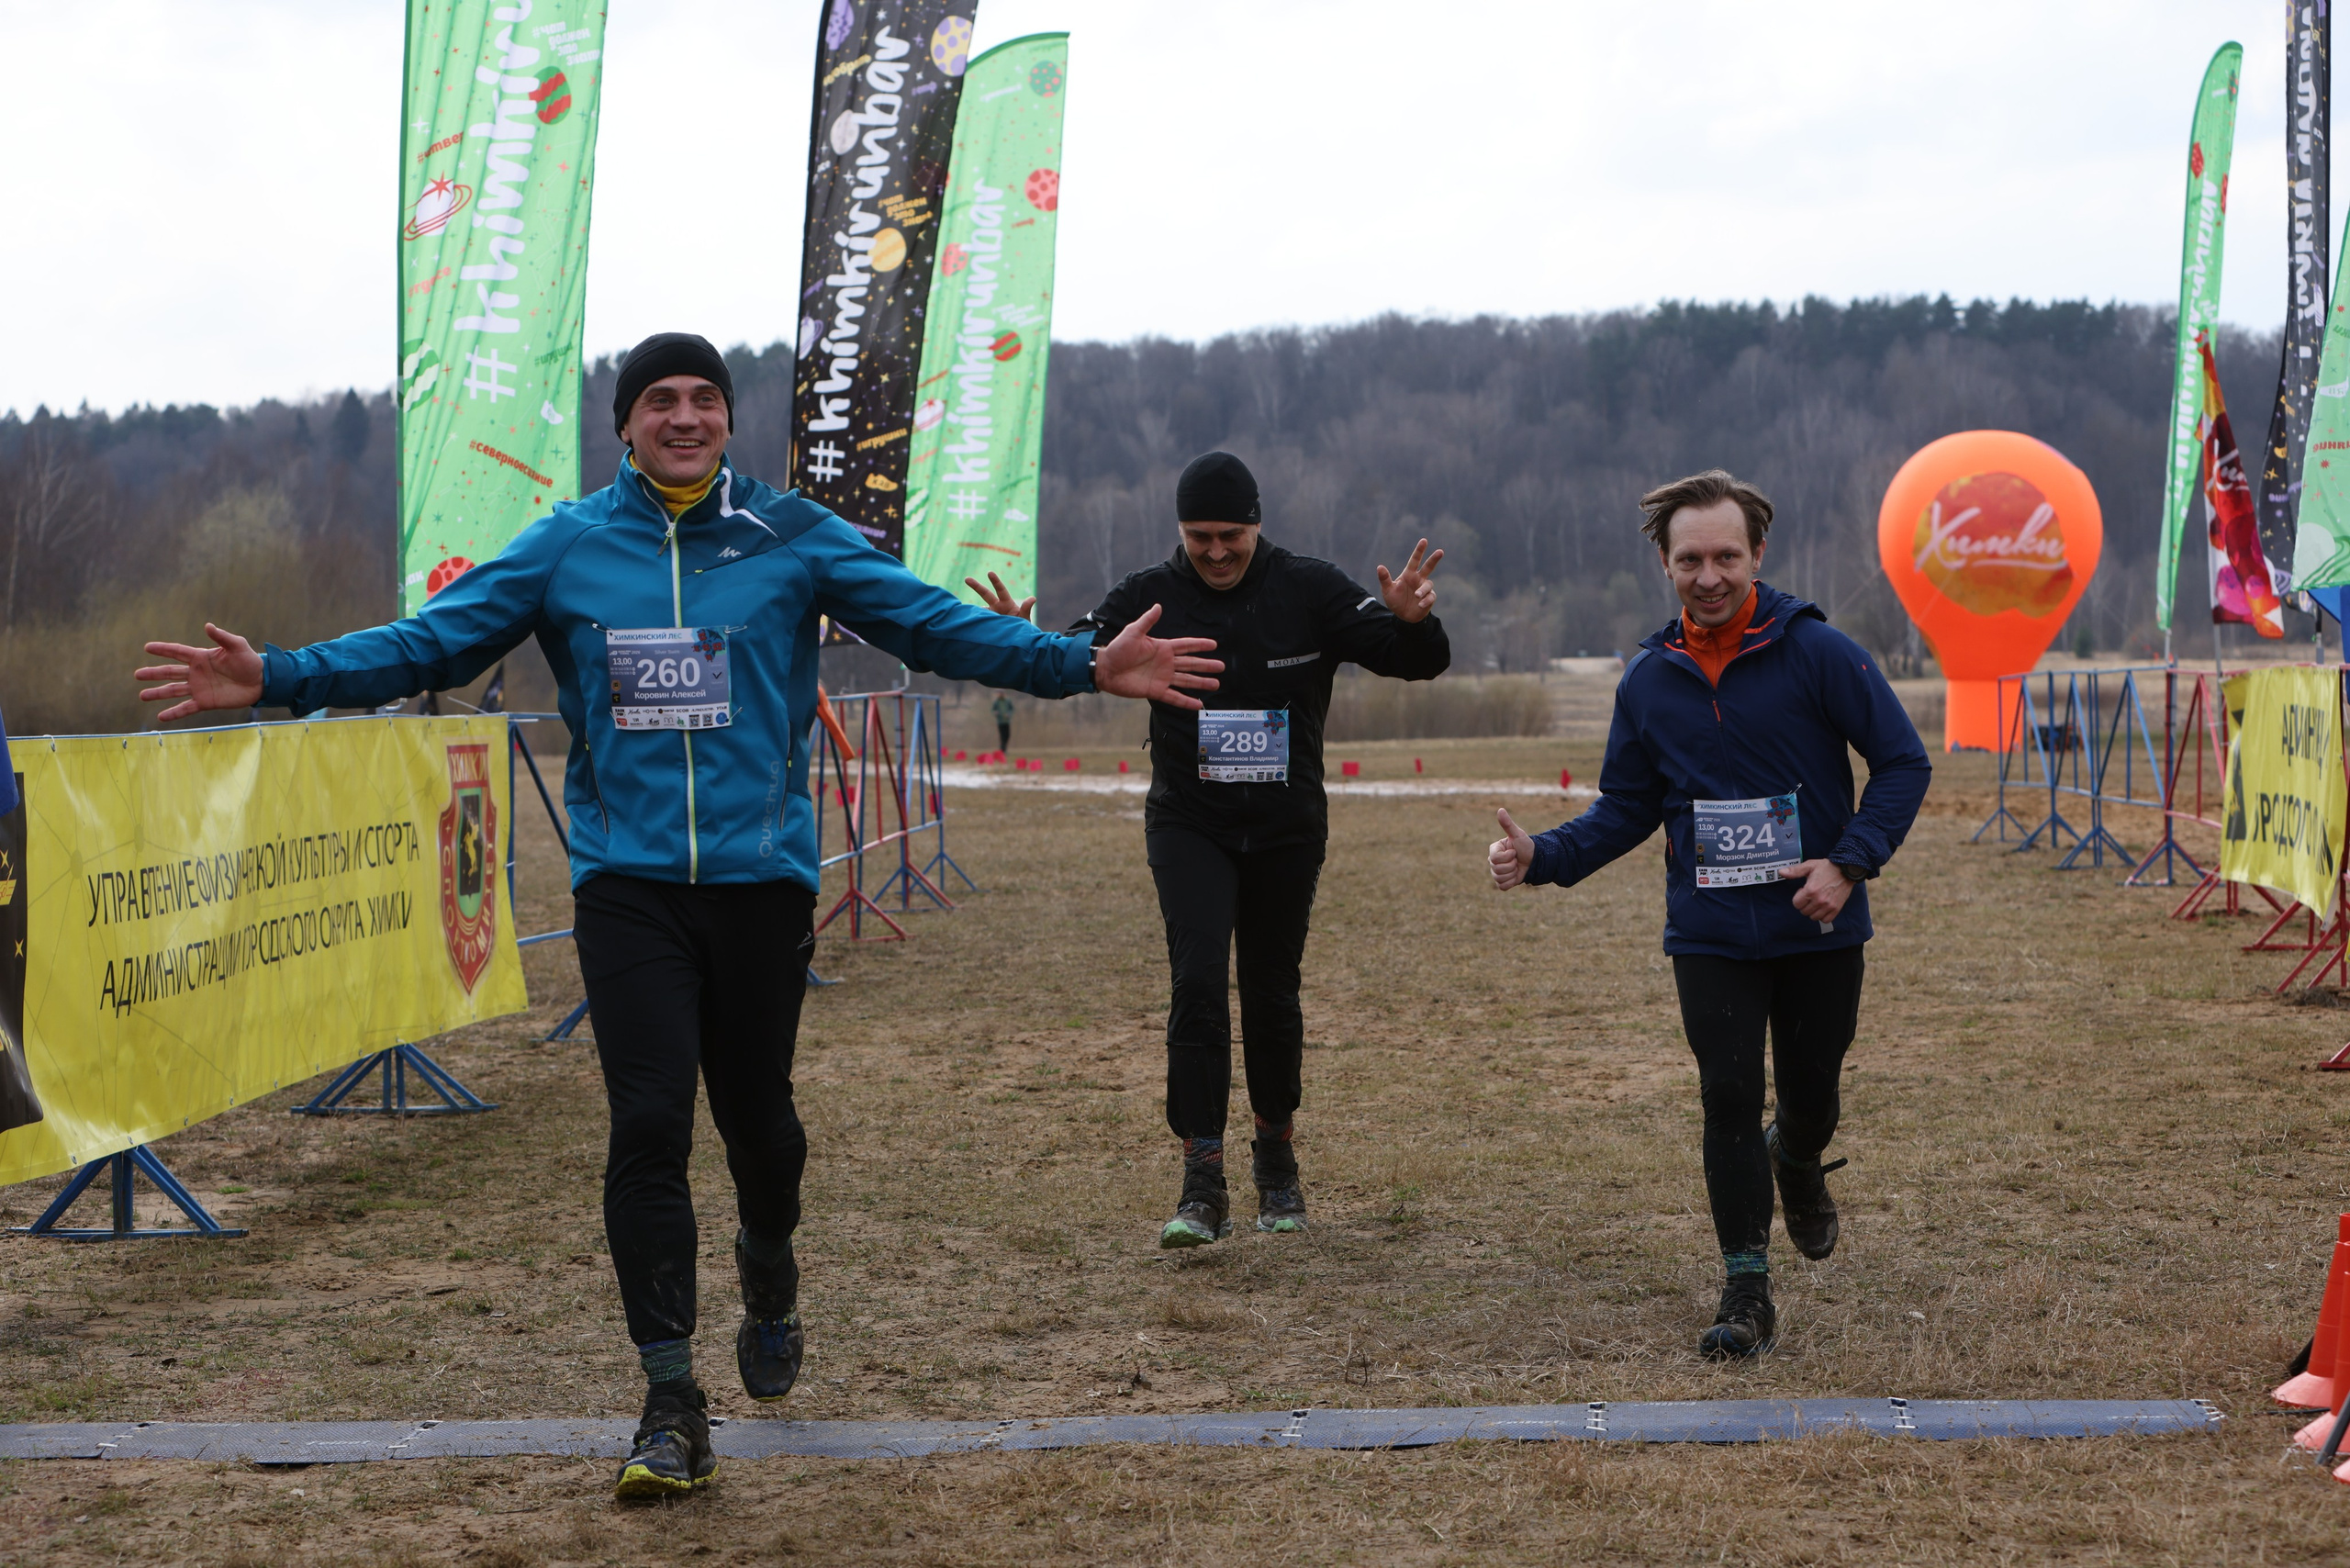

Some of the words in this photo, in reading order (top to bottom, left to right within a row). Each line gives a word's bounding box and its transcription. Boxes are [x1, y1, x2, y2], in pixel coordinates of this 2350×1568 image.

[808, 25, 911, 483] #khimkirunbar
[942, 176, 1006, 521] #khimkirunbar
[1913, 500, 2067, 572] Химки
[614, 633, 666, 641] ХИМКИНСКИЙ
[637, 657, 700, 689] 260
[1274, 656, 1301, 666] MOAX
[634, 691, 669, 700] Коровин
[671, 689, 706, 699] Алексей
[1220, 731, 1268, 753] 289
[758, 760, 779, 858] Quechua
[1718, 823, 1776, 852] 324
[1716, 854, 1746, 862] Морзюк
[1746, 849, 1780, 860] Дмитрий
[88, 860, 199, 927] УПРАВЛЕНИЕ
[353, 828, 362, 870] И
[365, 822, 420, 868] СПОРТА
[368, 890, 412, 937] ХИМКИ
